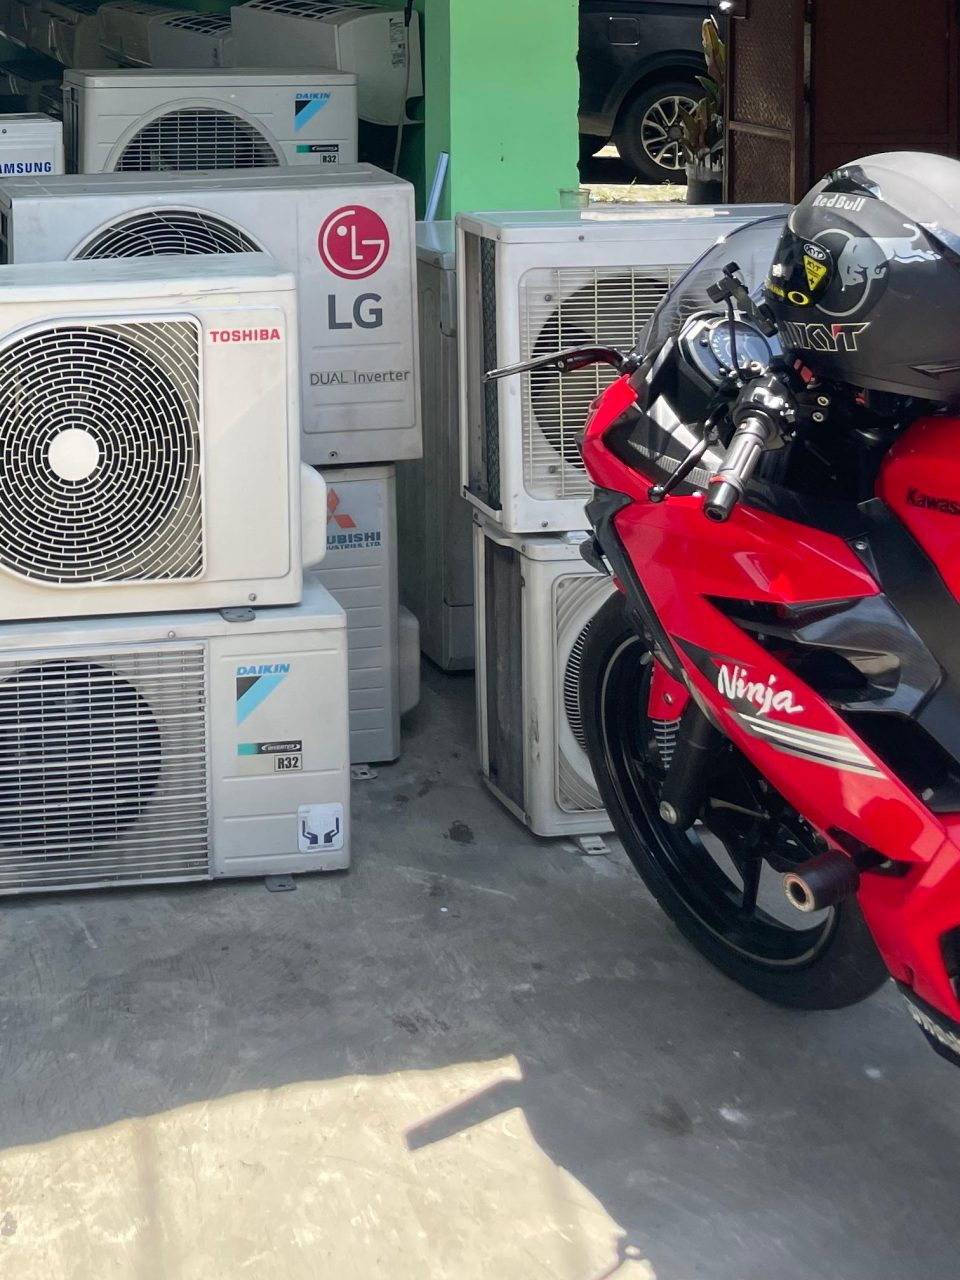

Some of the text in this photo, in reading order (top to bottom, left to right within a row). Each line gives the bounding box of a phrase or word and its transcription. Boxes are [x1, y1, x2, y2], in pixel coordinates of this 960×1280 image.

[327, 293, 384, 329] LG
[210, 328, 281, 343] TOSHIBA
[792, 322, 871, 351] KYT
[310, 370, 411, 386] DUAL Inverter
[327, 532, 381, 545] UBISHI
[237, 664, 290, 676] DAIKIN
[718, 664, 804, 716] Ninja
[278, 757, 299, 769] R32
